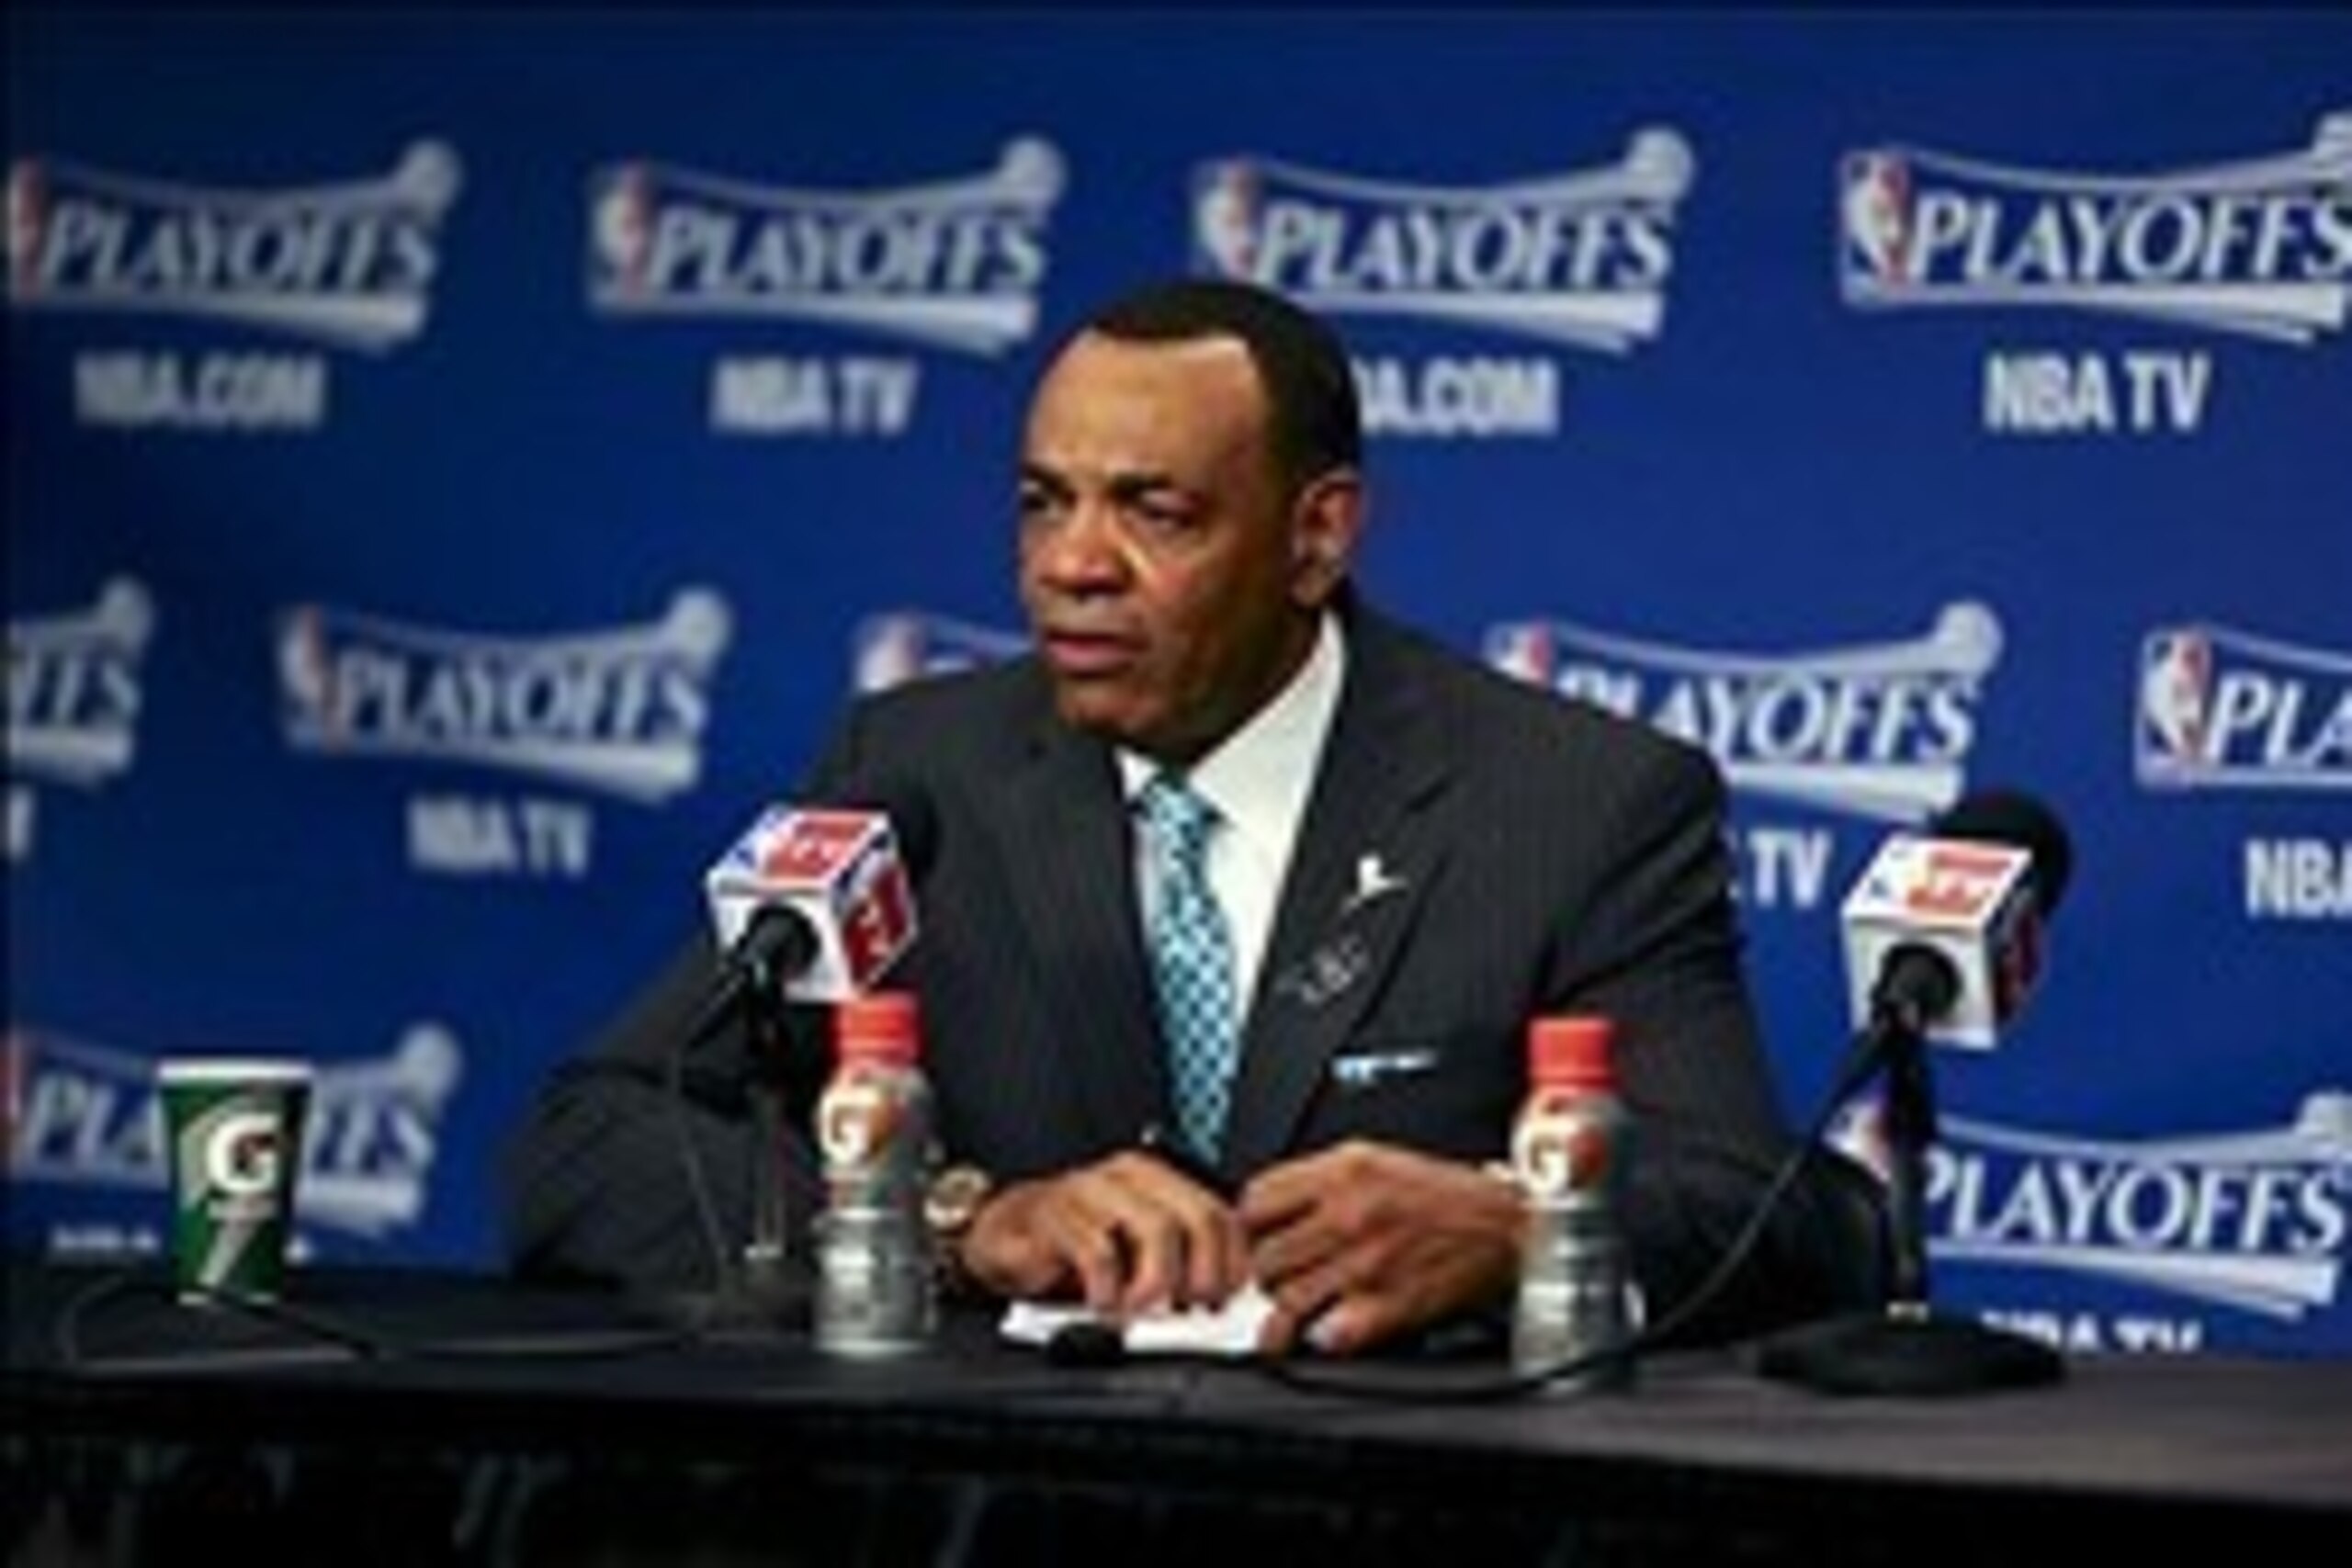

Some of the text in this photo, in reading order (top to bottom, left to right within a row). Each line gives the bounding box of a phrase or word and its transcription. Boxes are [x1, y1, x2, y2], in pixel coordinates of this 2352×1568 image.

[39, 204, 439, 296] PLAYOFFS
[647, 205, 1046, 296] PLAYOFFS
[1253, 198, 1674, 288] PLAYOFFS
[1906, 191, 2352, 280] PLAYOFFS
[710, 356, 918, 434] NBA TV
[1984, 352, 2211, 432] NBA TV
[334, 649, 707, 739] PLAYOFFS
[407, 795, 593, 875] NBA TV
[1749, 830, 1830, 908] TV
[2245, 838, 2352, 918] NB
[206, 1112, 281, 1194] G
